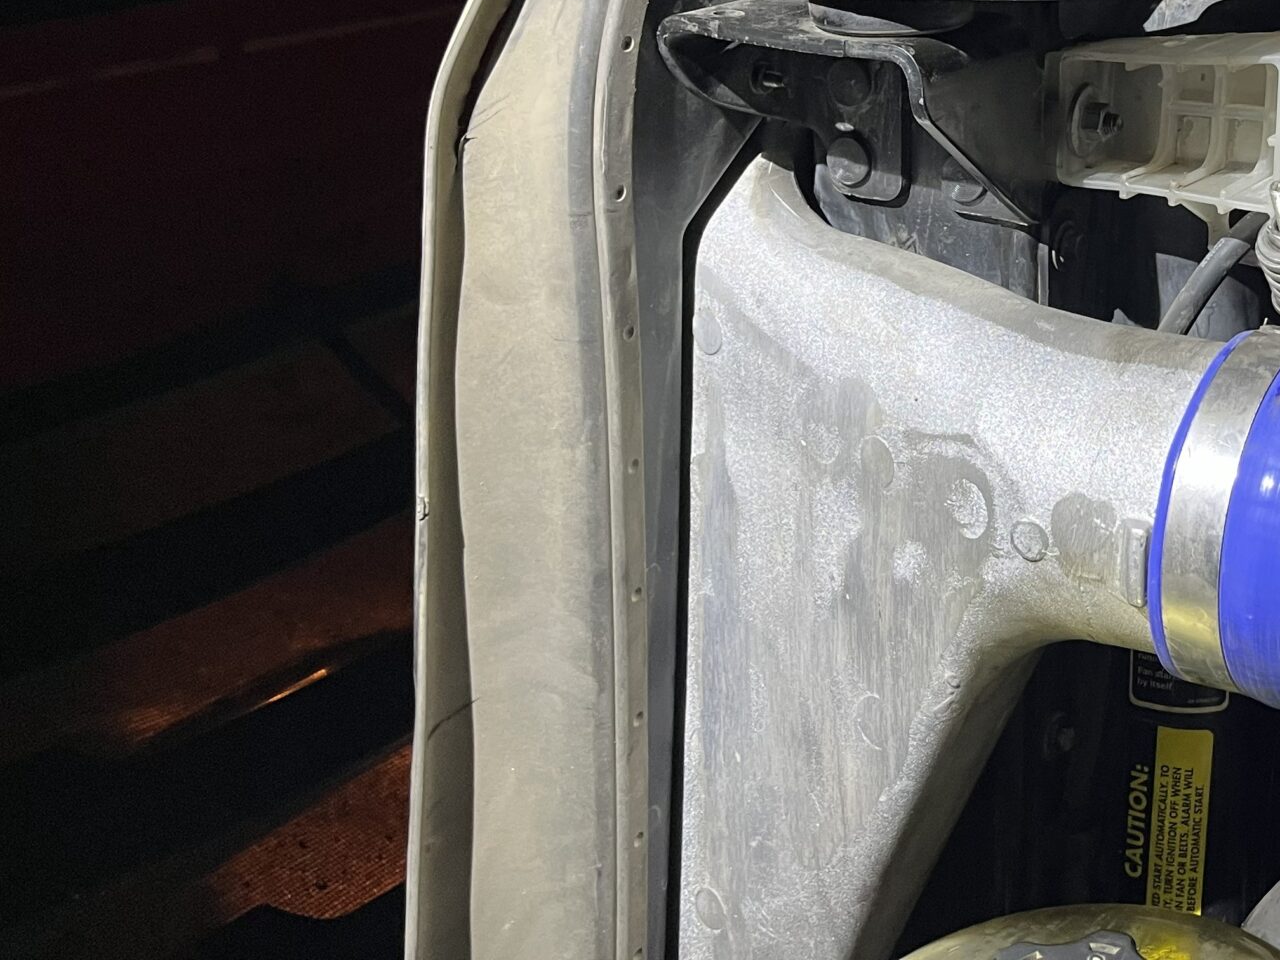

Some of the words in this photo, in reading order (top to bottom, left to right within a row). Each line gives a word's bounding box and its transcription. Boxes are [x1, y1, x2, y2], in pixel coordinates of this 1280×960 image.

[1161, 765, 1169, 777] TO
[1171, 767, 1181, 797] WHEN
[1183, 768, 1193, 789] WILL
[1169, 800, 1179, 818] OFF
[1181, 793, 1192, 826] ALARM
[1192, 784, 1204, 814] START.
[1124, 763, 1149, 878] CAUTION:
[1155, 781, 1169, 860] AUTOMATICALLY.
[1166, 822, 1178, 866] IGNITION
[1179, 830, 1189, 858] BELTS.
[1189, 817, 1202, 873] AUTOMATIC
[1152, 864, 1162, 890] START
[1165, 869, 1174, 894] TURN
[1177, 862, 1186, 875] OR
[1176, 879, 1185, 897] FAN
[1186, 877, 1197, 911] BEFORE
